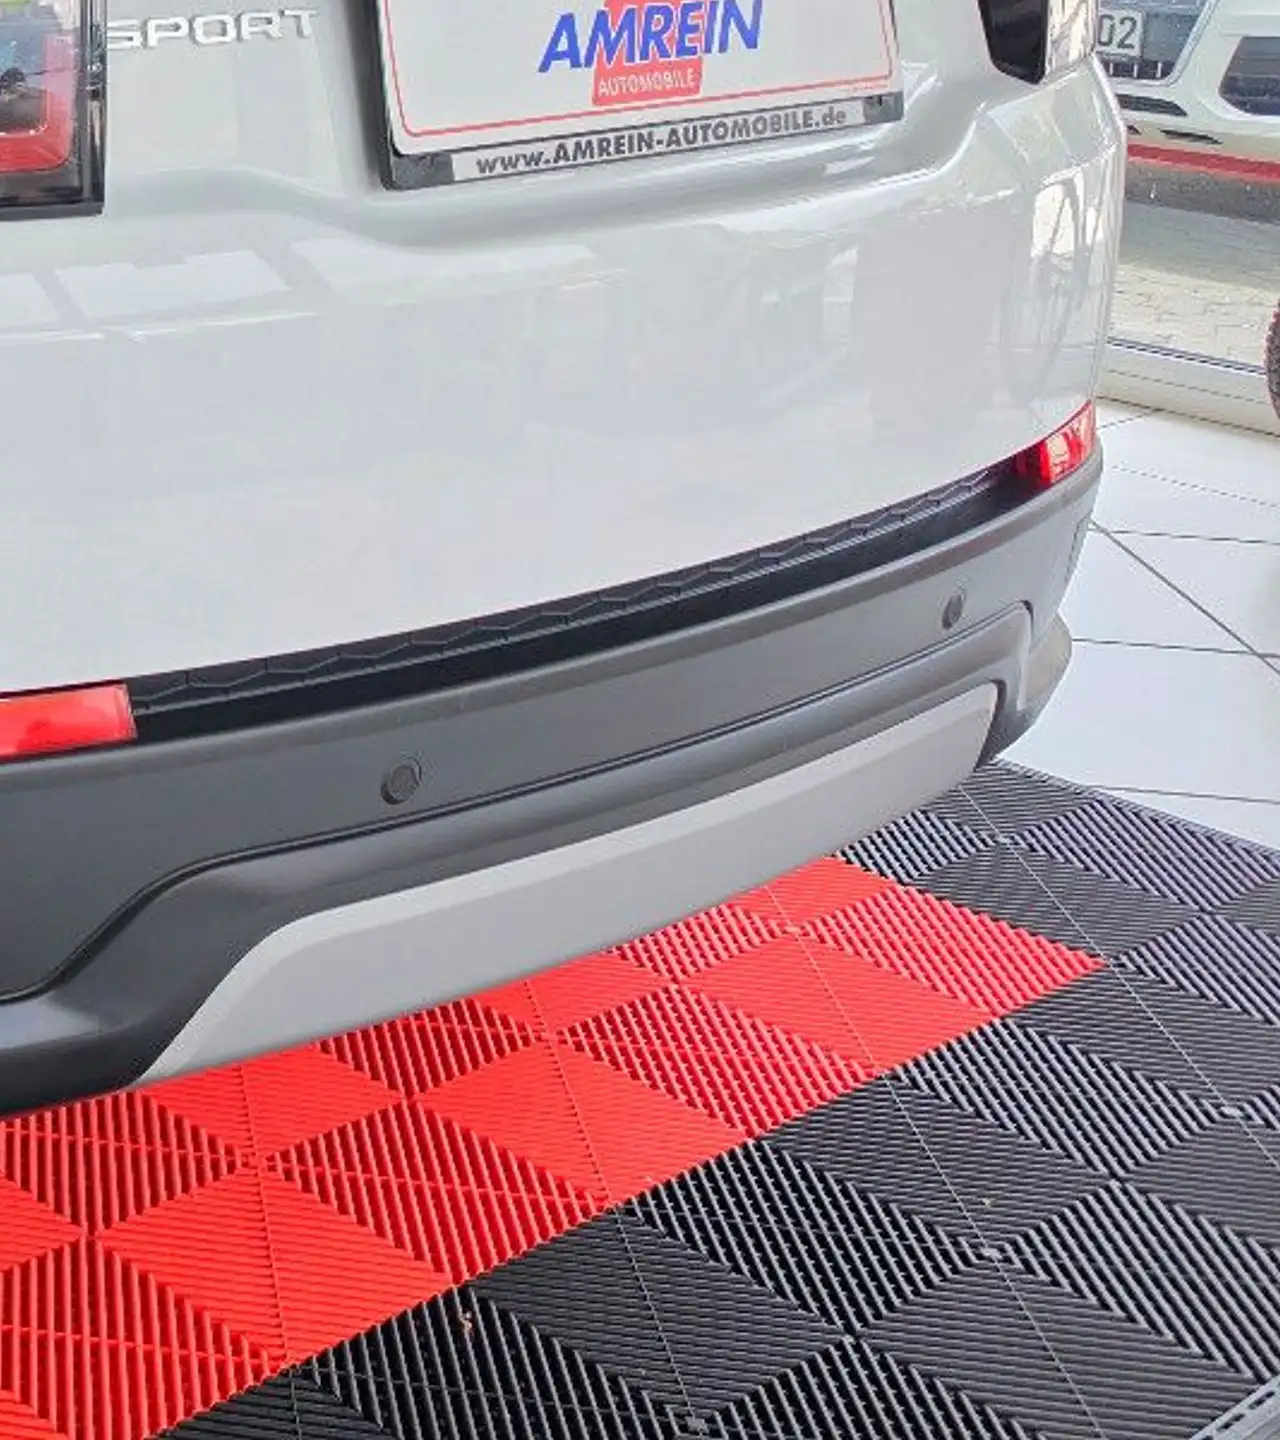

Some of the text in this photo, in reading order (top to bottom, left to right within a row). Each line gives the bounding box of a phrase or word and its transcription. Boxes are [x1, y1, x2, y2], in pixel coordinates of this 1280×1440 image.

[107, 9, 318, 50] SPORT
[598, 67, 695, 97] AUTOMOBILE
[476, 106, 847, 175] www.AMREIN-AUTOMOBILE.de
